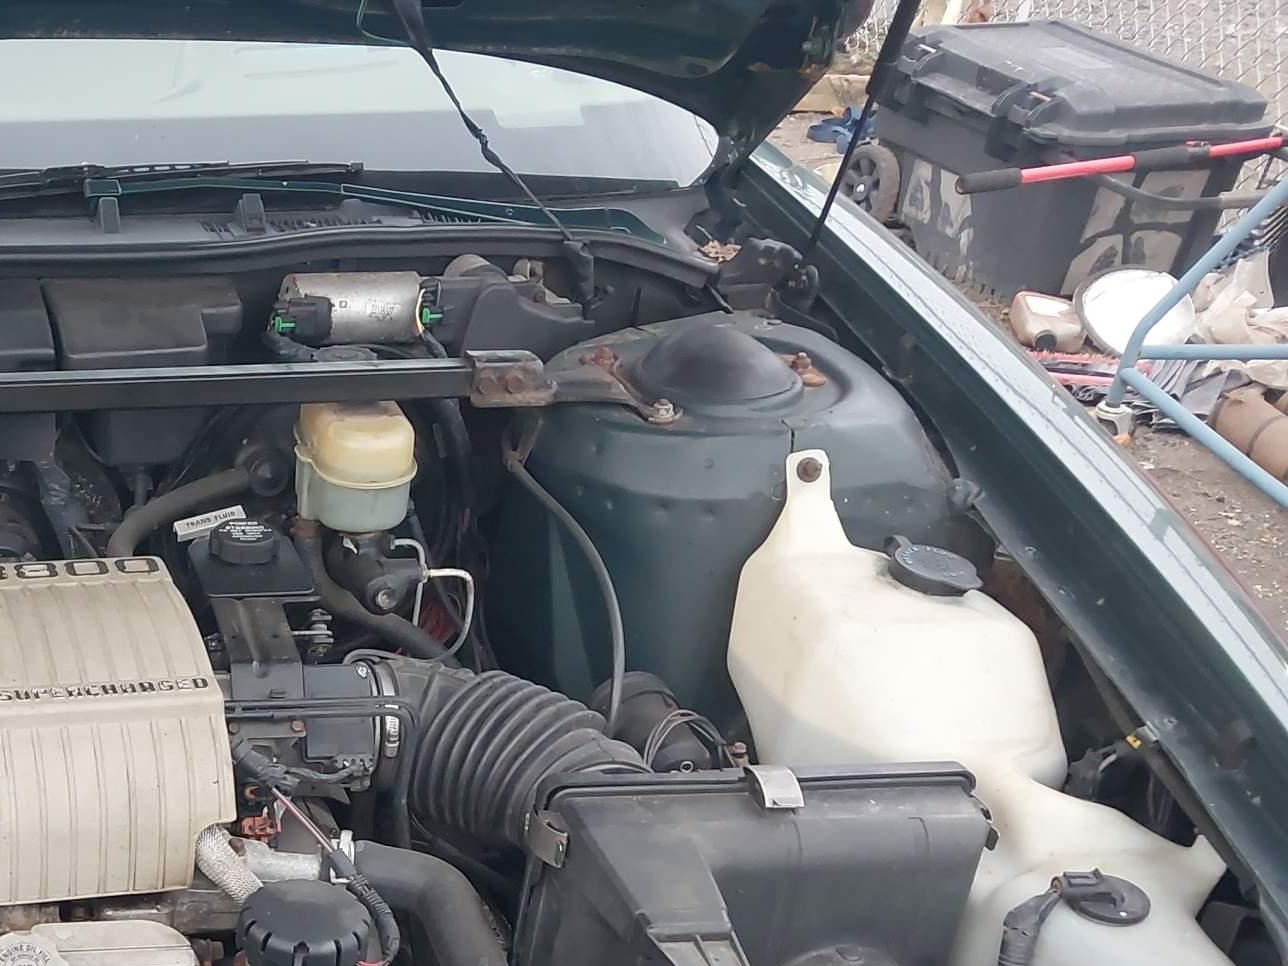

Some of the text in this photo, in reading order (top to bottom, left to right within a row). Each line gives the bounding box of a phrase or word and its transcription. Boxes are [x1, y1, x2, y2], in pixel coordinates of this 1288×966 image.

[185, 510, 236, 529] TRANS FLUID
[0, 944, 24, 962] ENGINE
[25, 944, 37, 953] OIL
[37, 948, 51, 964] FILL
